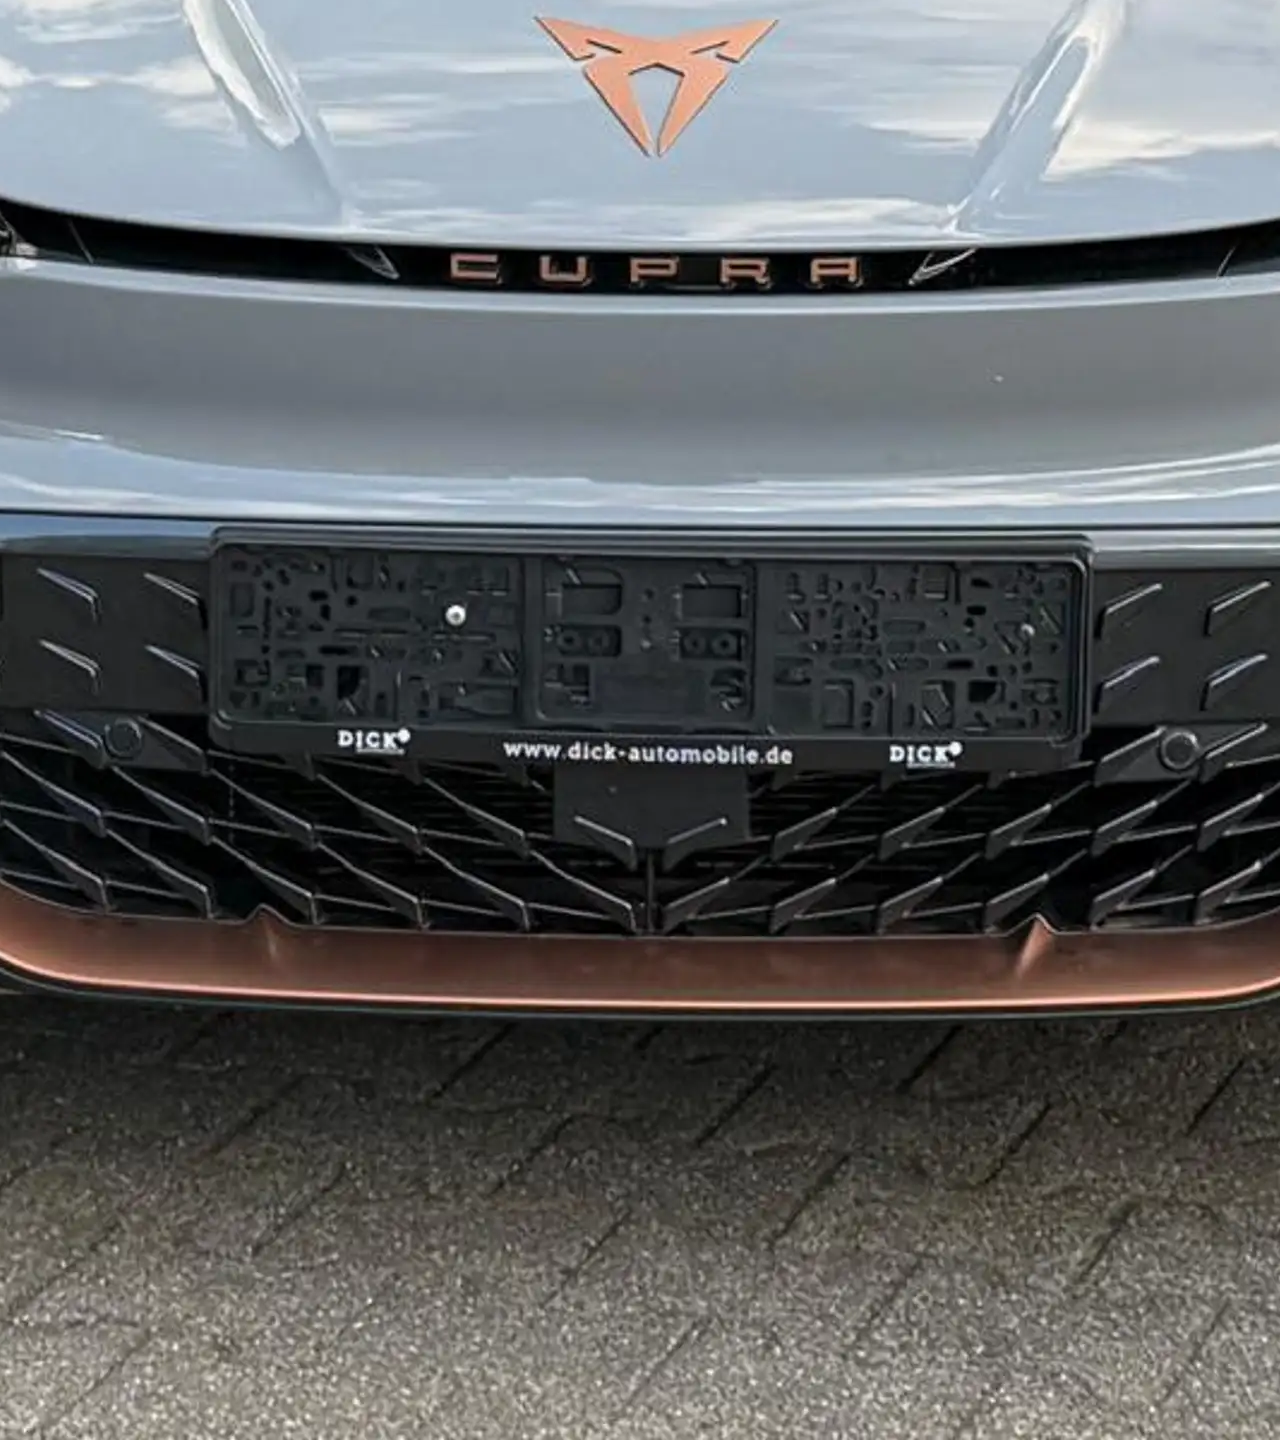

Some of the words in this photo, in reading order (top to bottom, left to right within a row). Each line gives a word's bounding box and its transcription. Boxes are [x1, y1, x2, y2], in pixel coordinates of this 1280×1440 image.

[450, 252, 861, 285] CUPRA
[337, 729, 401, 750] DICK
[502, 741, 794, 766] www.dick-automobile.de
[888, 744, 952, 763] DICK
